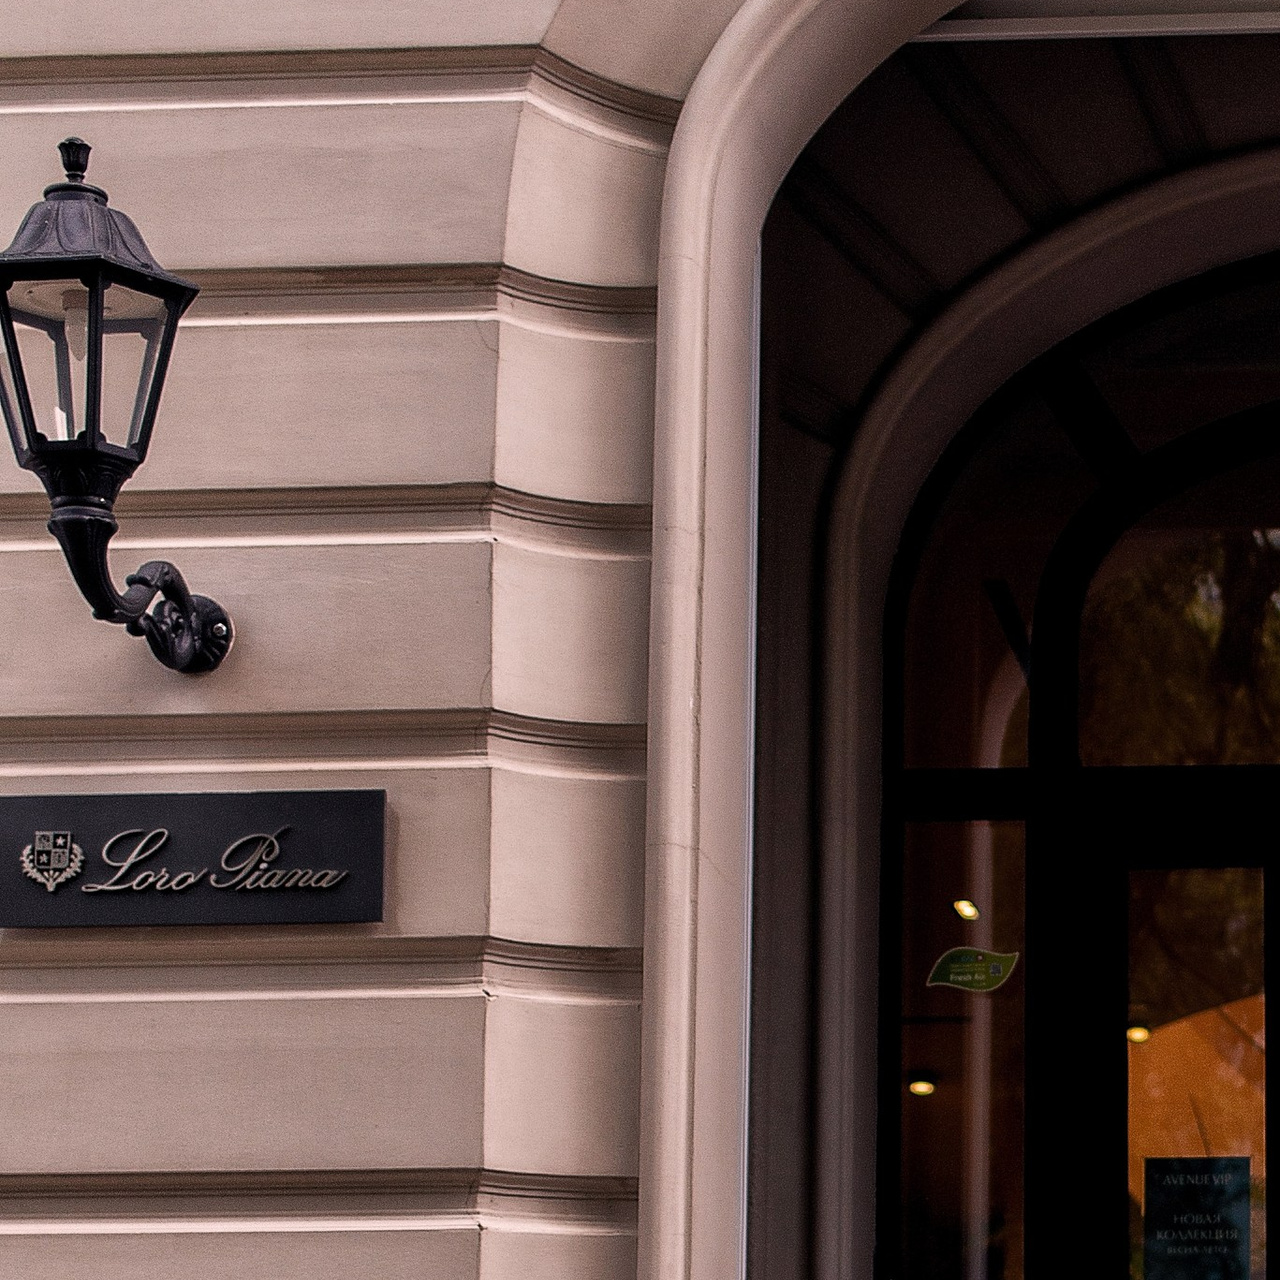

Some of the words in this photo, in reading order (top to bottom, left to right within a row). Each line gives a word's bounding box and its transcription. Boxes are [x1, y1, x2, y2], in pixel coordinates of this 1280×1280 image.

[81, 828, 208, 892] Loro
[209, 826, 349, 892] Piana
[1162, 1173, 1210, 1185] AVENUE
[1212, 1173, 1233, 1185] VIP
[1173, 1213, 1221, 1224] НОВАЯ
[1156, 1229, 1239, 1241] КОЛЛЕКЦИЯ
